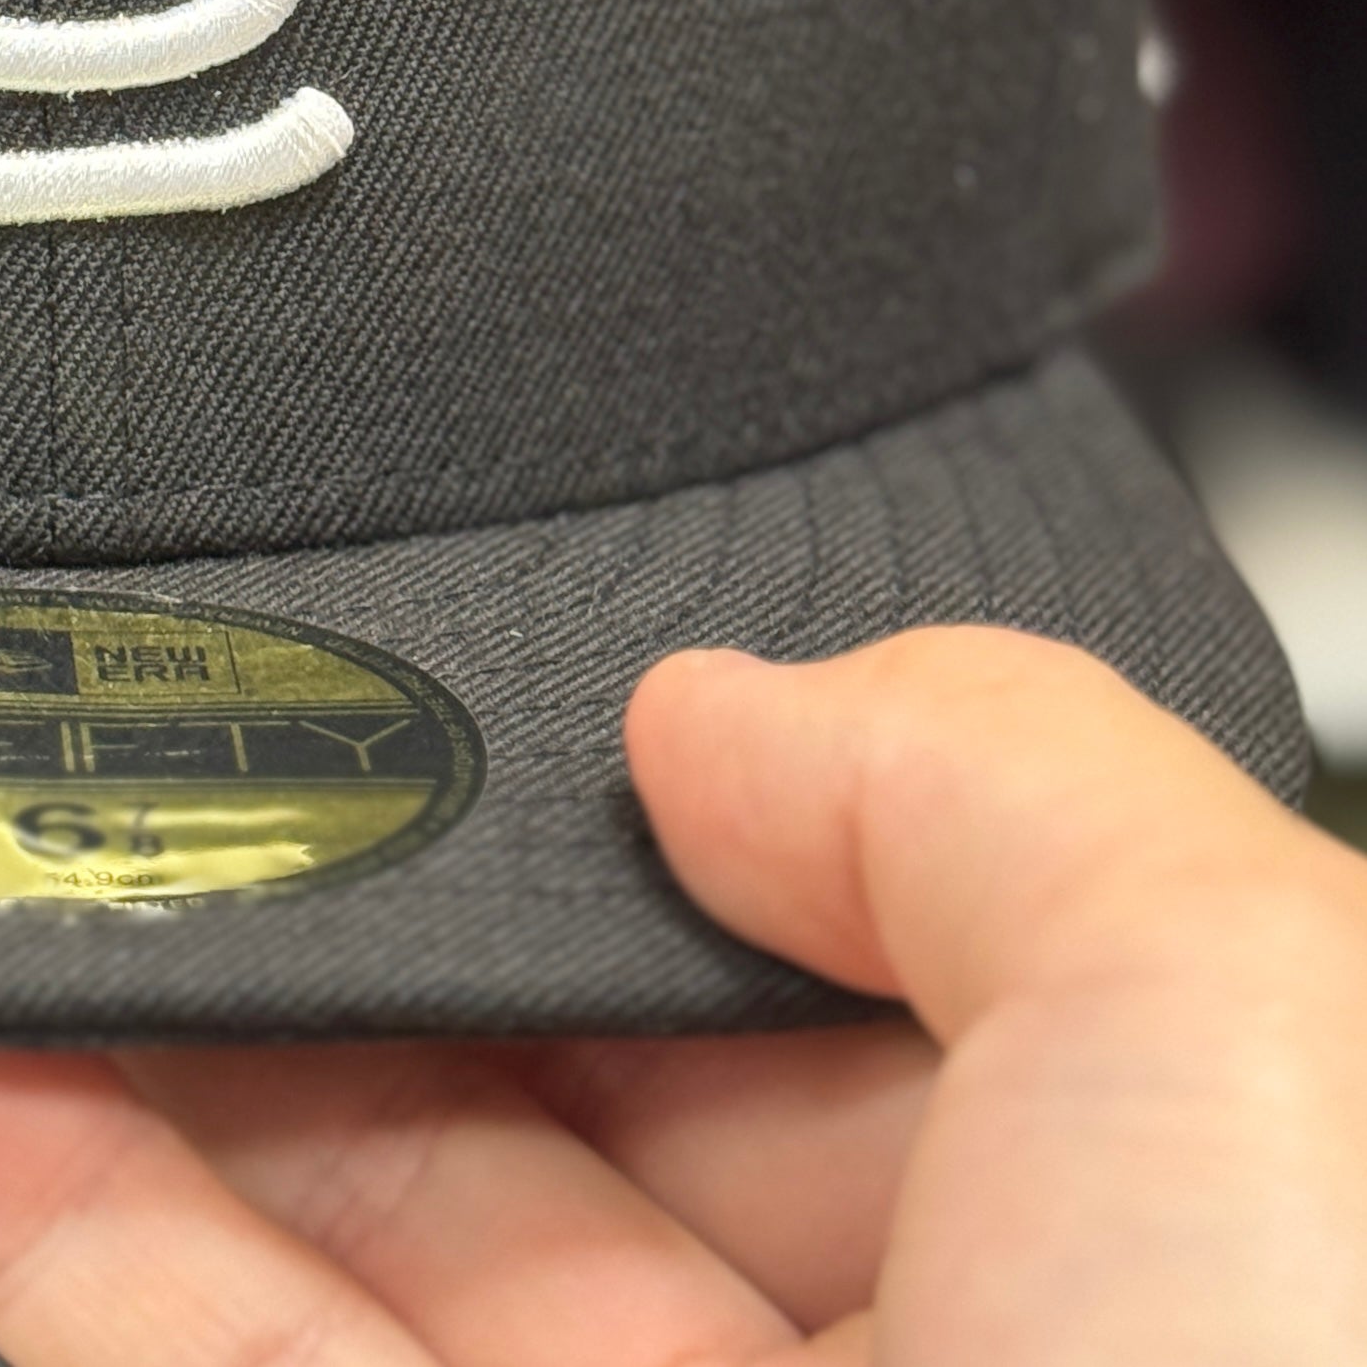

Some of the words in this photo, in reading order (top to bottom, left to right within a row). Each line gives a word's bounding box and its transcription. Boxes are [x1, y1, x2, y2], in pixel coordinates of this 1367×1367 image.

[94, 645, 207, 663] NEW
[97, 664, 211, 683] ERA
[13, 801, 107, 864] 6
